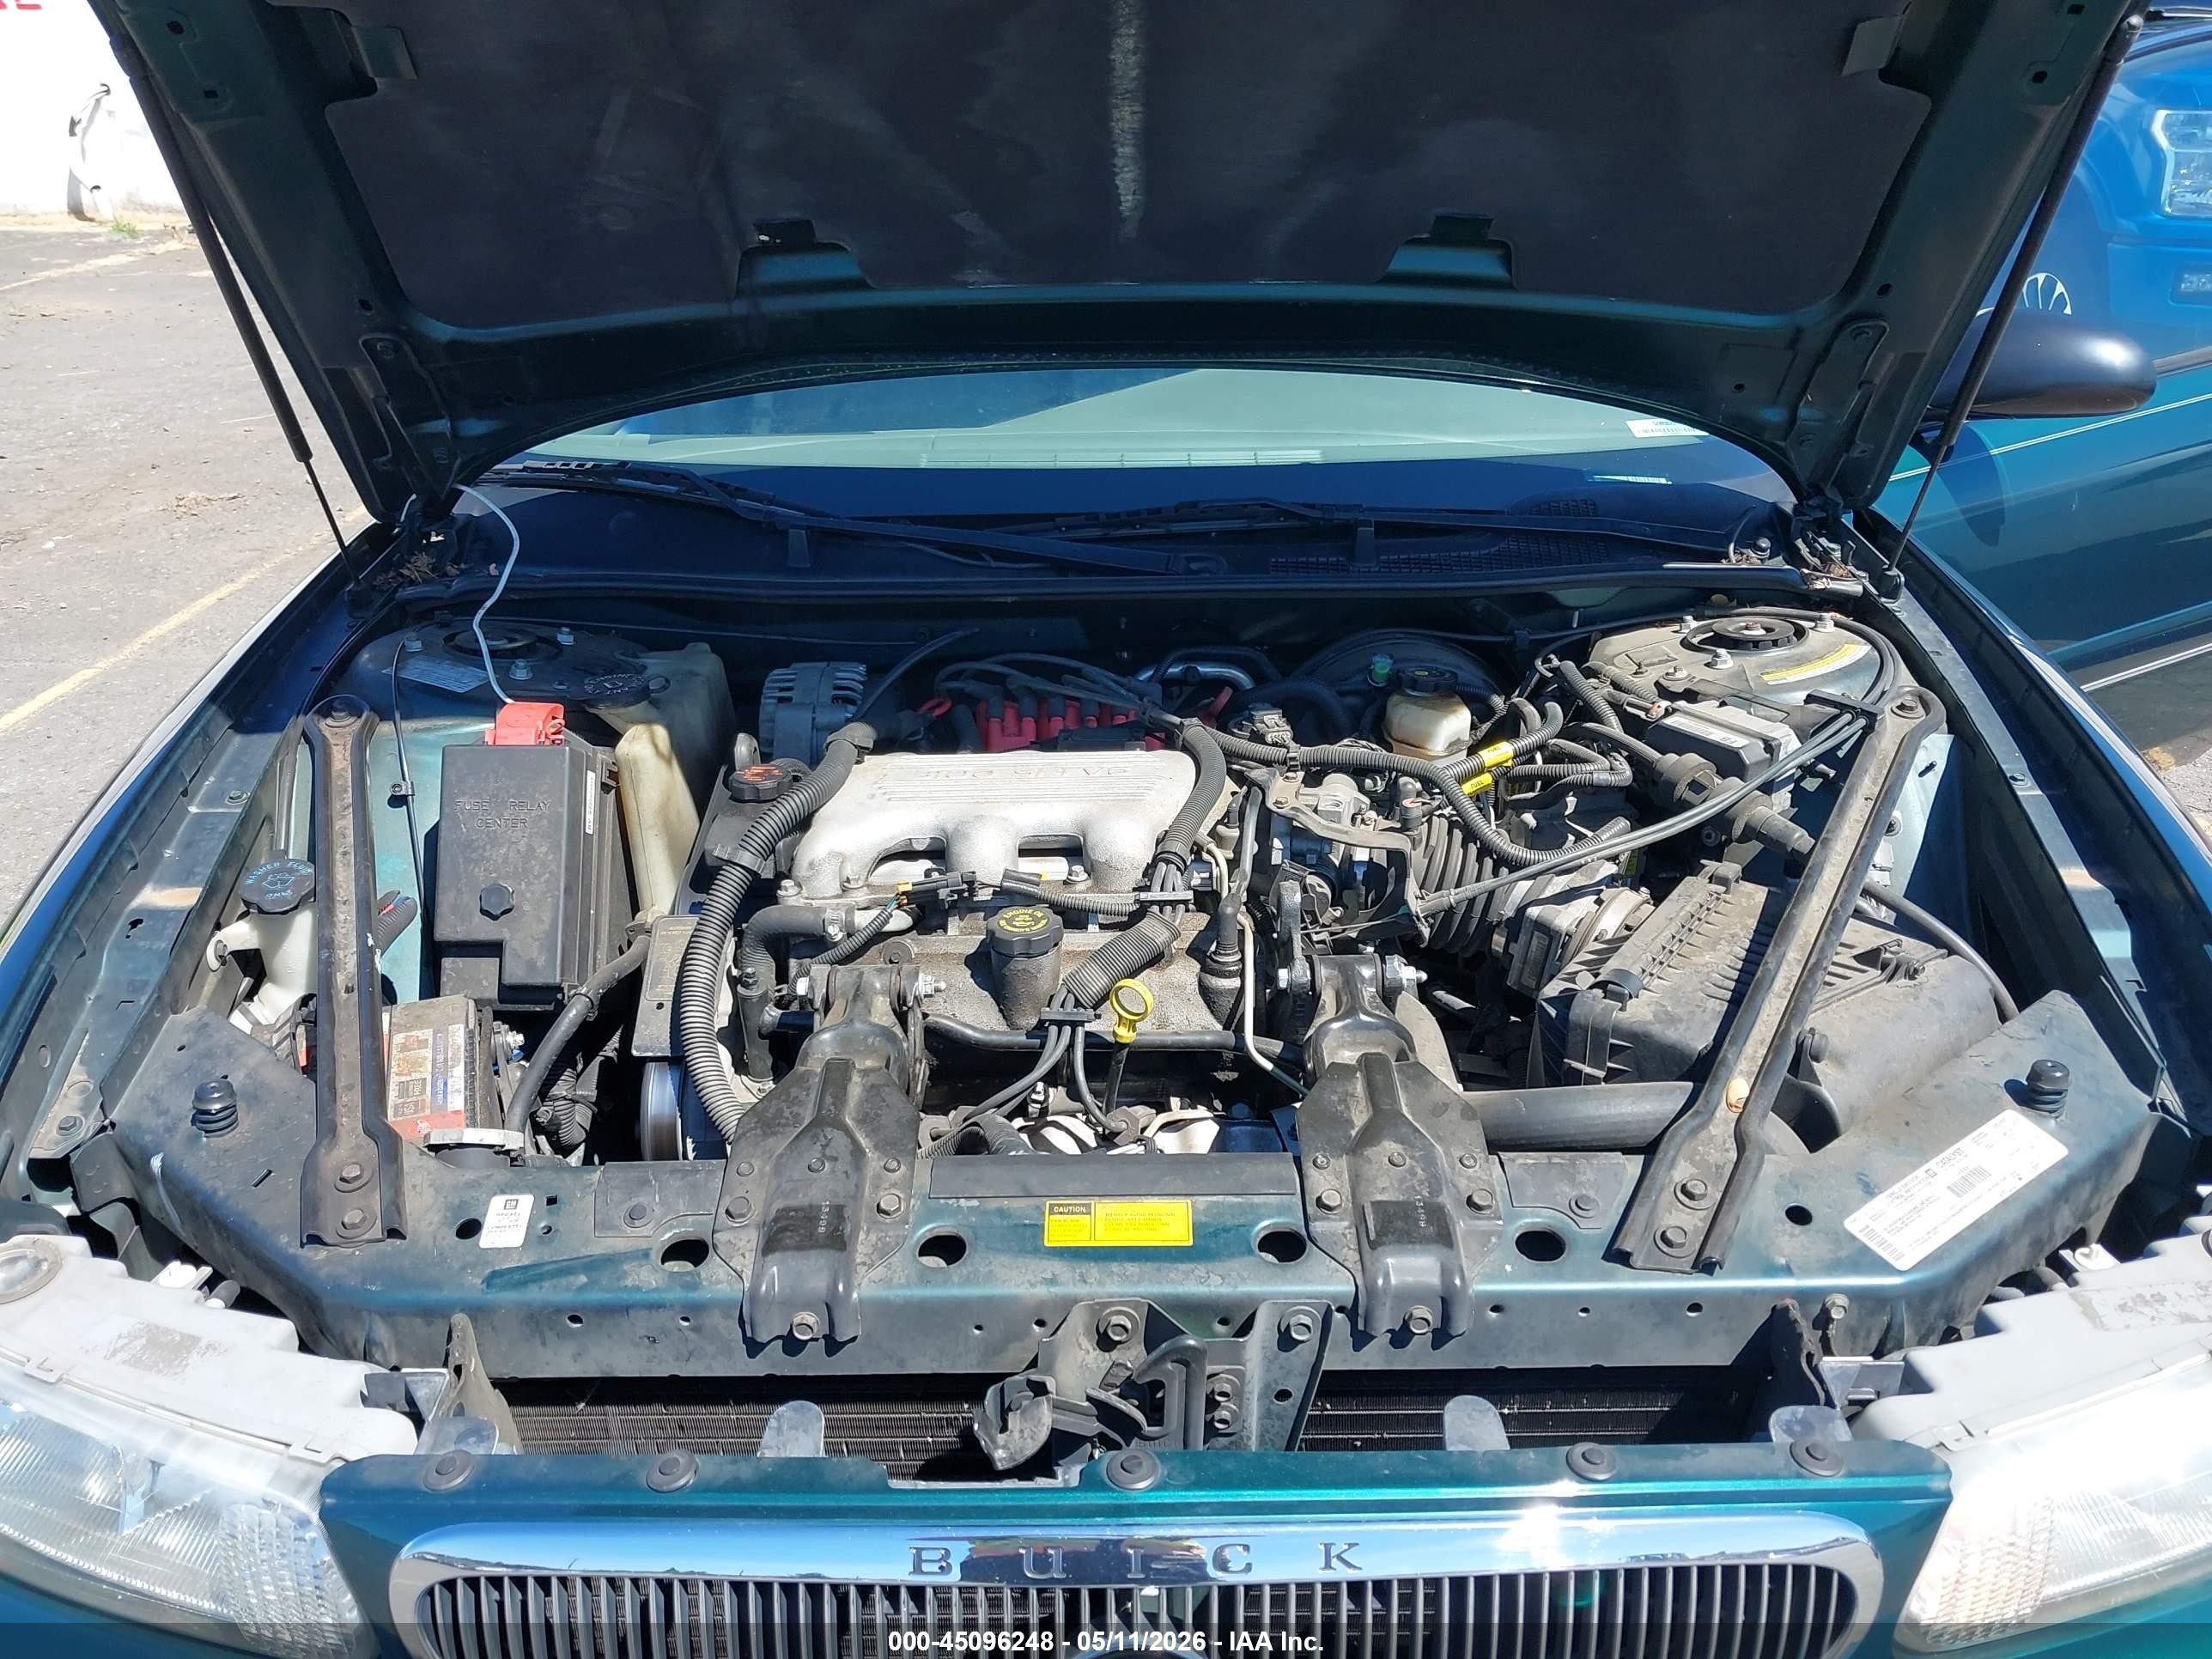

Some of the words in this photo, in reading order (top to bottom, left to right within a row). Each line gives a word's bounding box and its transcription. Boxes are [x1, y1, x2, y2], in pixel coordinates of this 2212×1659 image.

[1470, 779, 1485, 789] FUEL
[454, 799, 489, 811] FUSE
[509, 800, 551, 812] RELAY
[476, 817, 529, 830] CENTER
[244, 861, 281, 885] WASHER
[288, 861, 313, 876] FLUID
[1003, 908, 1033, 919] ENGINE
[1936, 1147, 1965, 1169] CATALYST
[908, 1542, 1363, 1580] BUICK
